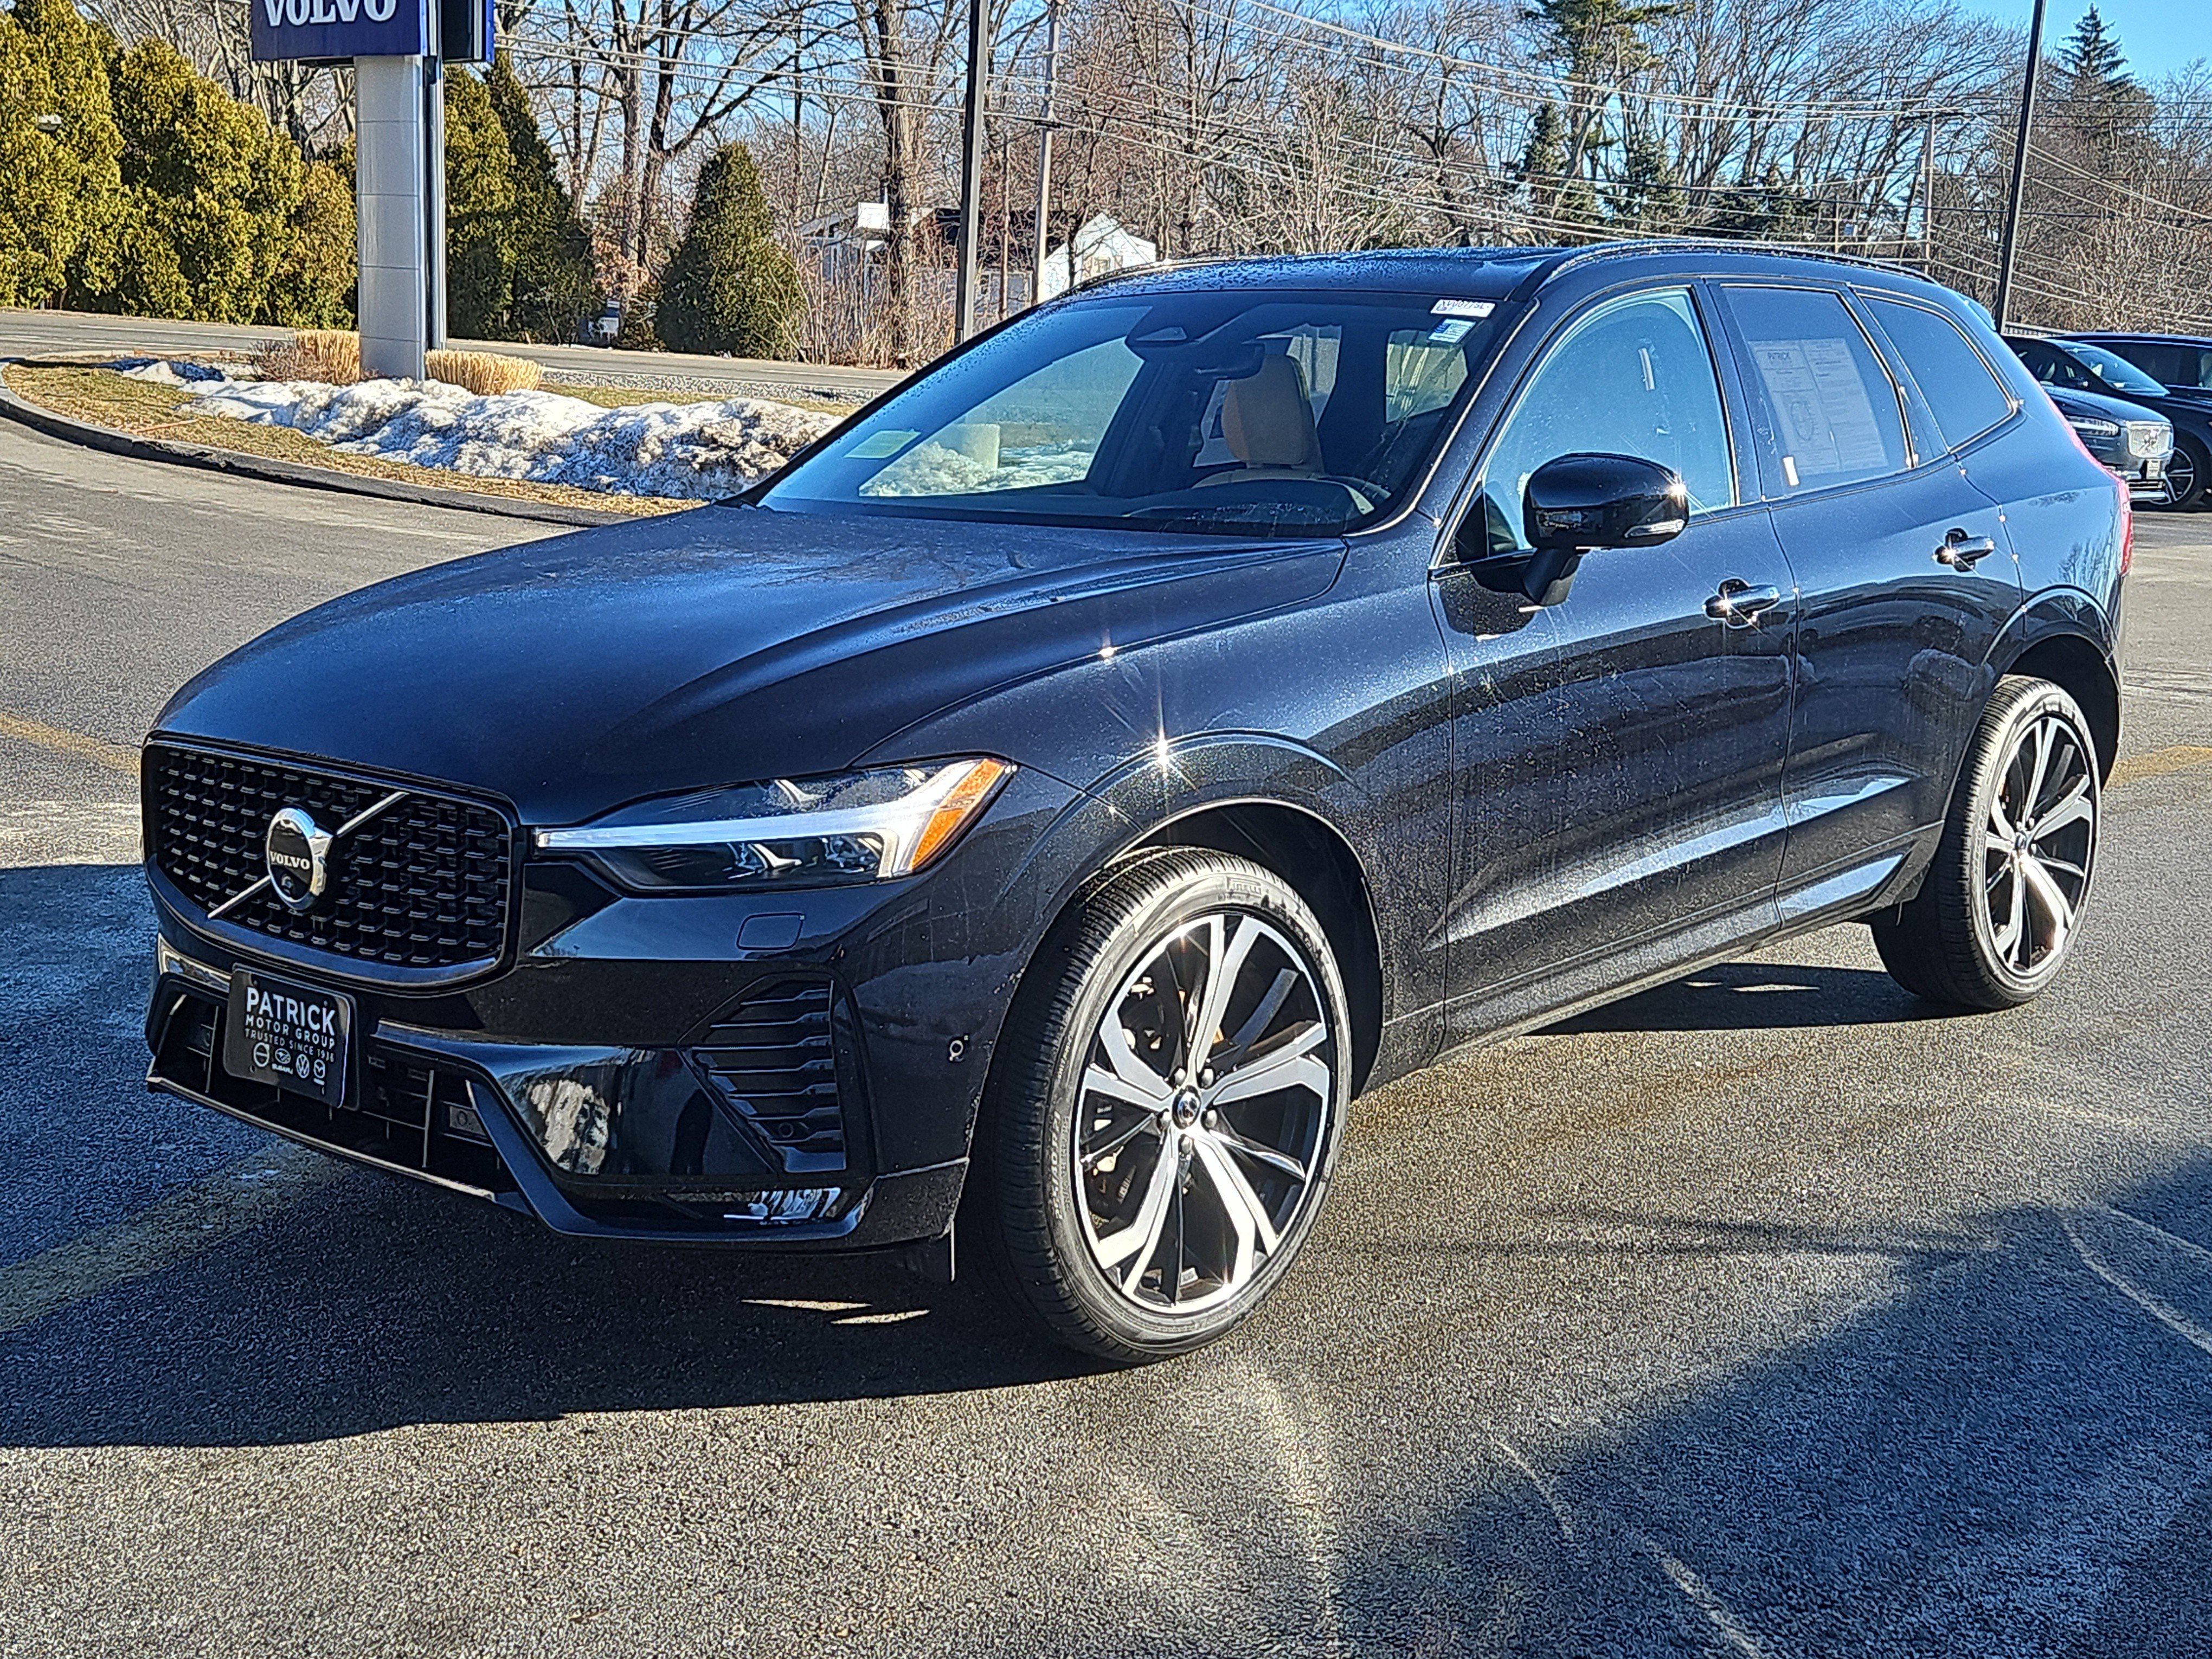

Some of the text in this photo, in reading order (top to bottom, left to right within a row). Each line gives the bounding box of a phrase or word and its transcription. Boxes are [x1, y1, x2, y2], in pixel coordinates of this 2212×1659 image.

[264, 0, 397, 26] VOLVO
[271, 851, 310, 870] VOLVO
[247, 987, 335, 1036] PATRICK
[245, 1028, 286, 1046] TRUSTED
[289, 1040, 314, 1056] SINCE
[246, 1015, 335, 1050] MOTOR GROUP
